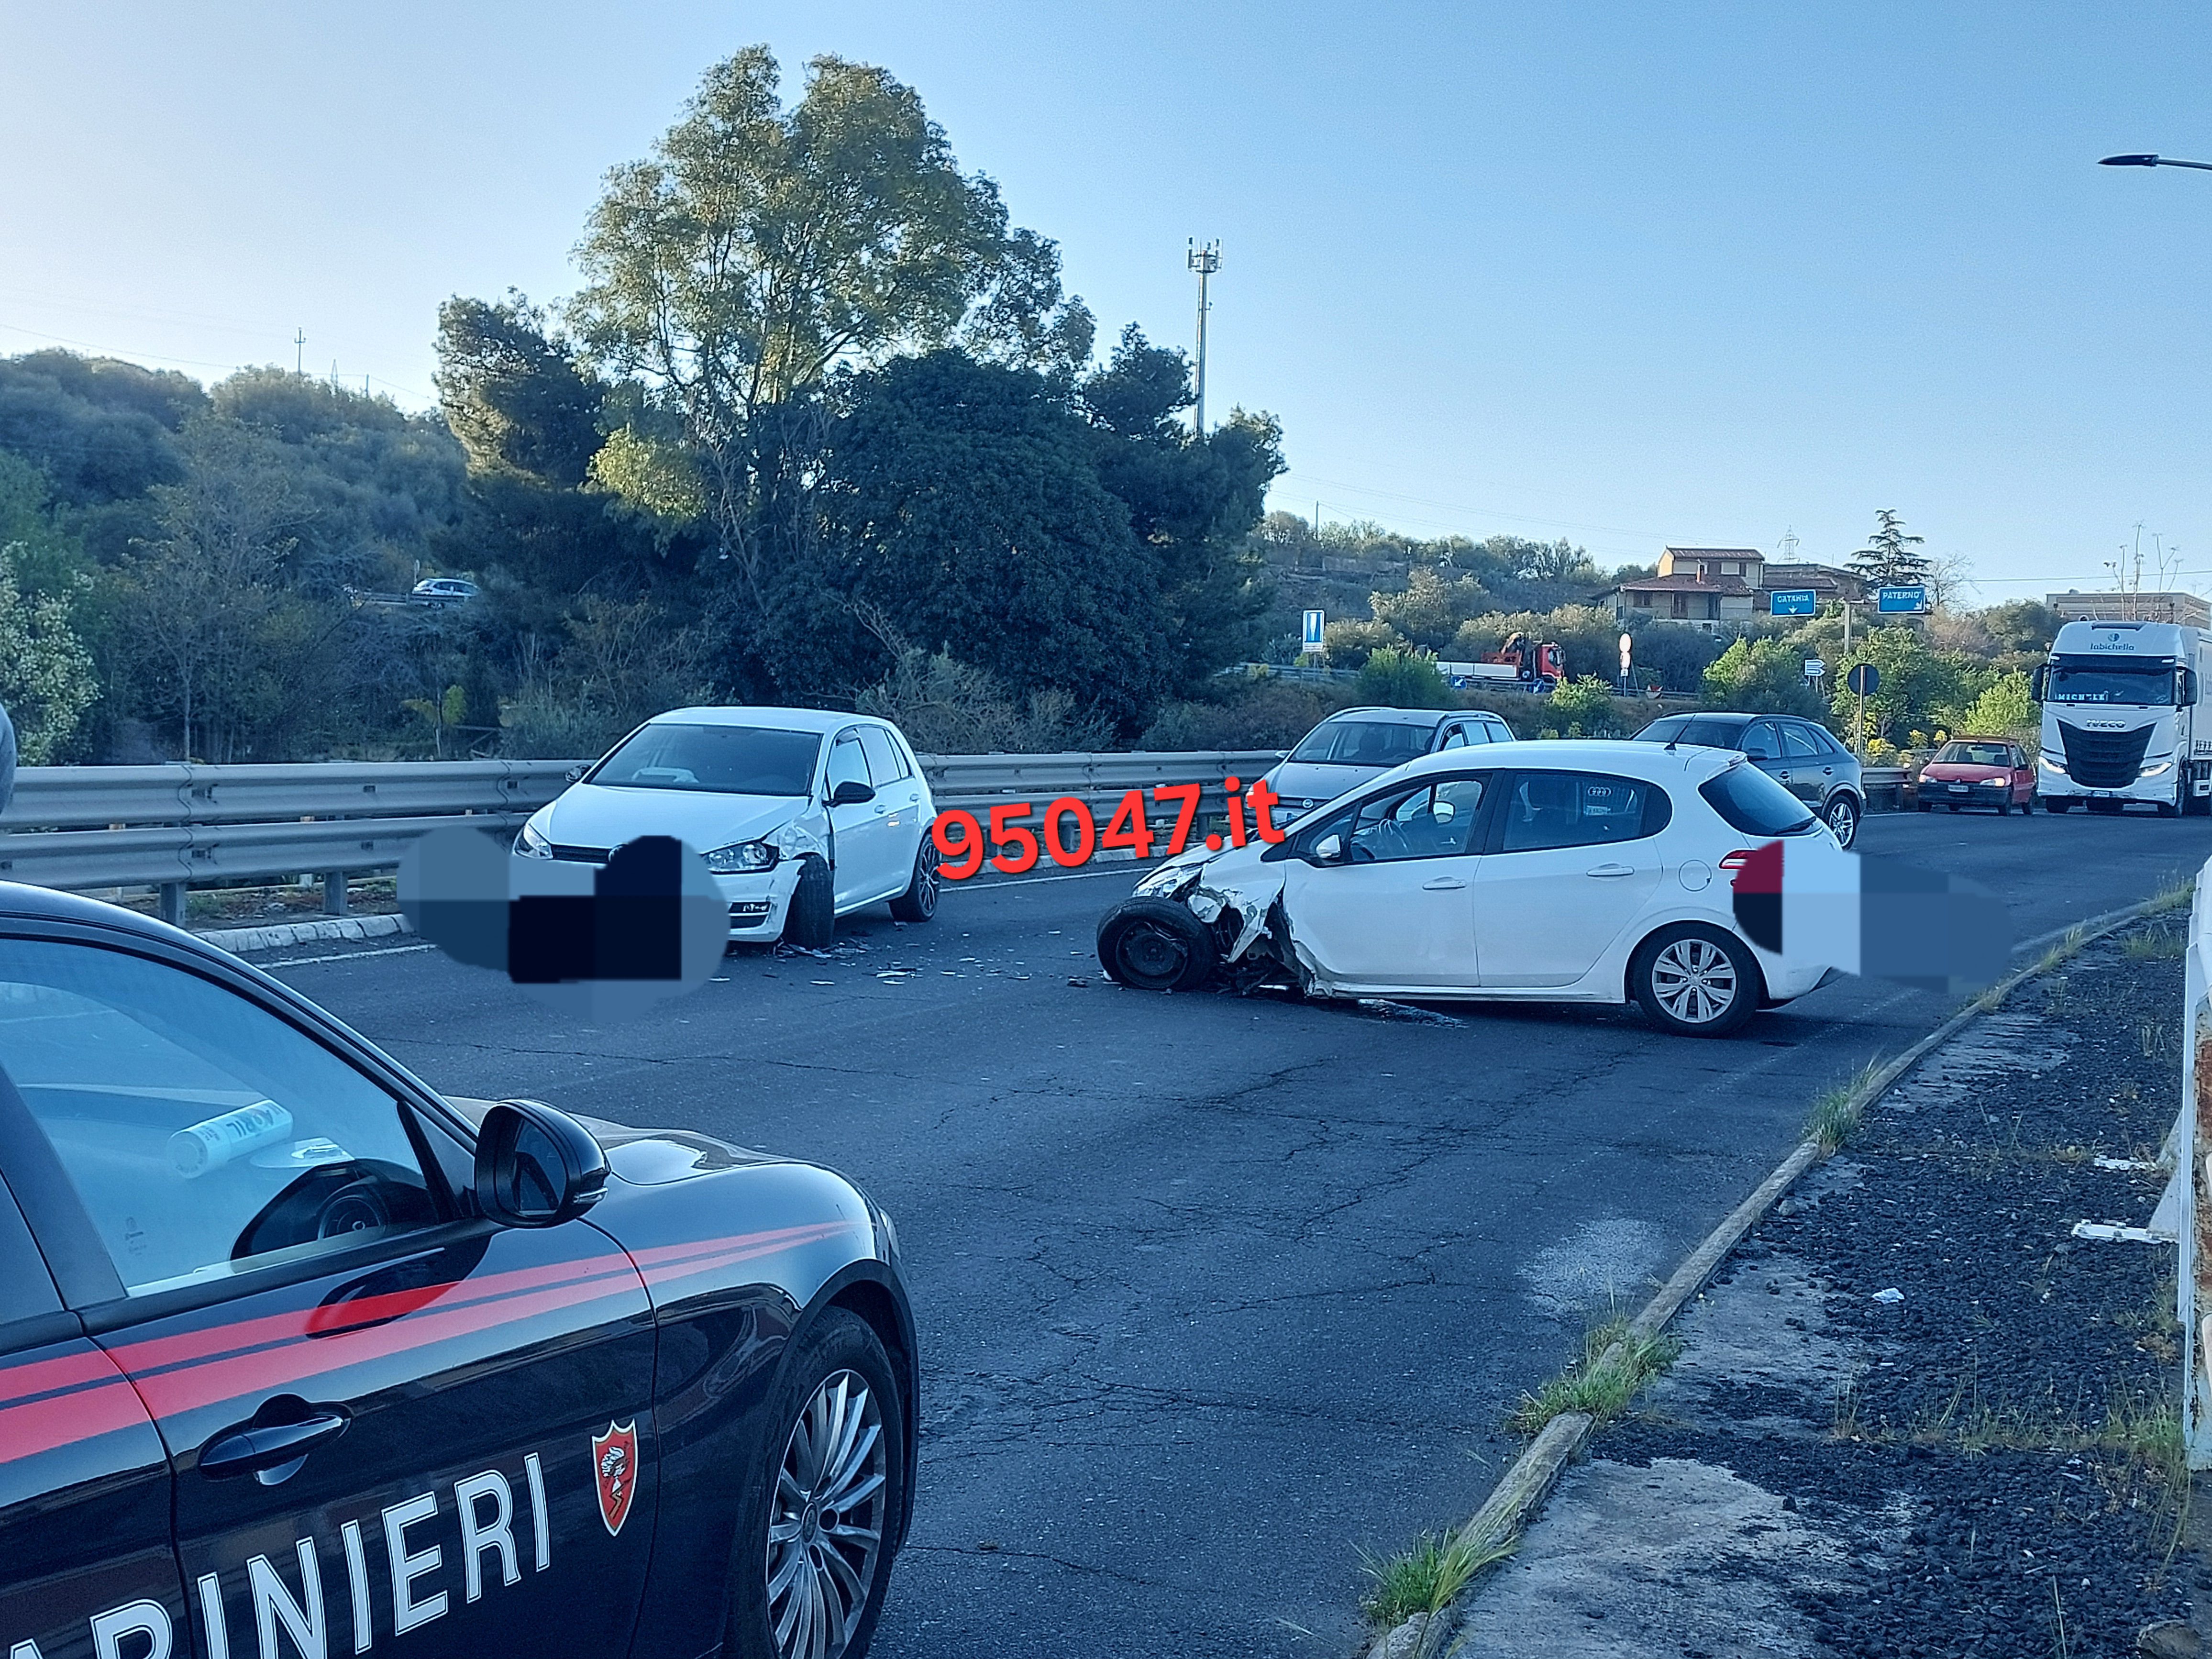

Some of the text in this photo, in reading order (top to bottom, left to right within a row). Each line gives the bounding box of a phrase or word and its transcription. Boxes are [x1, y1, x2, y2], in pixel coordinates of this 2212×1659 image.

[1777, 595, 1809, 603] CATANIA
[2086, 719, 2126, 728] IVECO
[10, 1452, 549, 1659] INIERI
